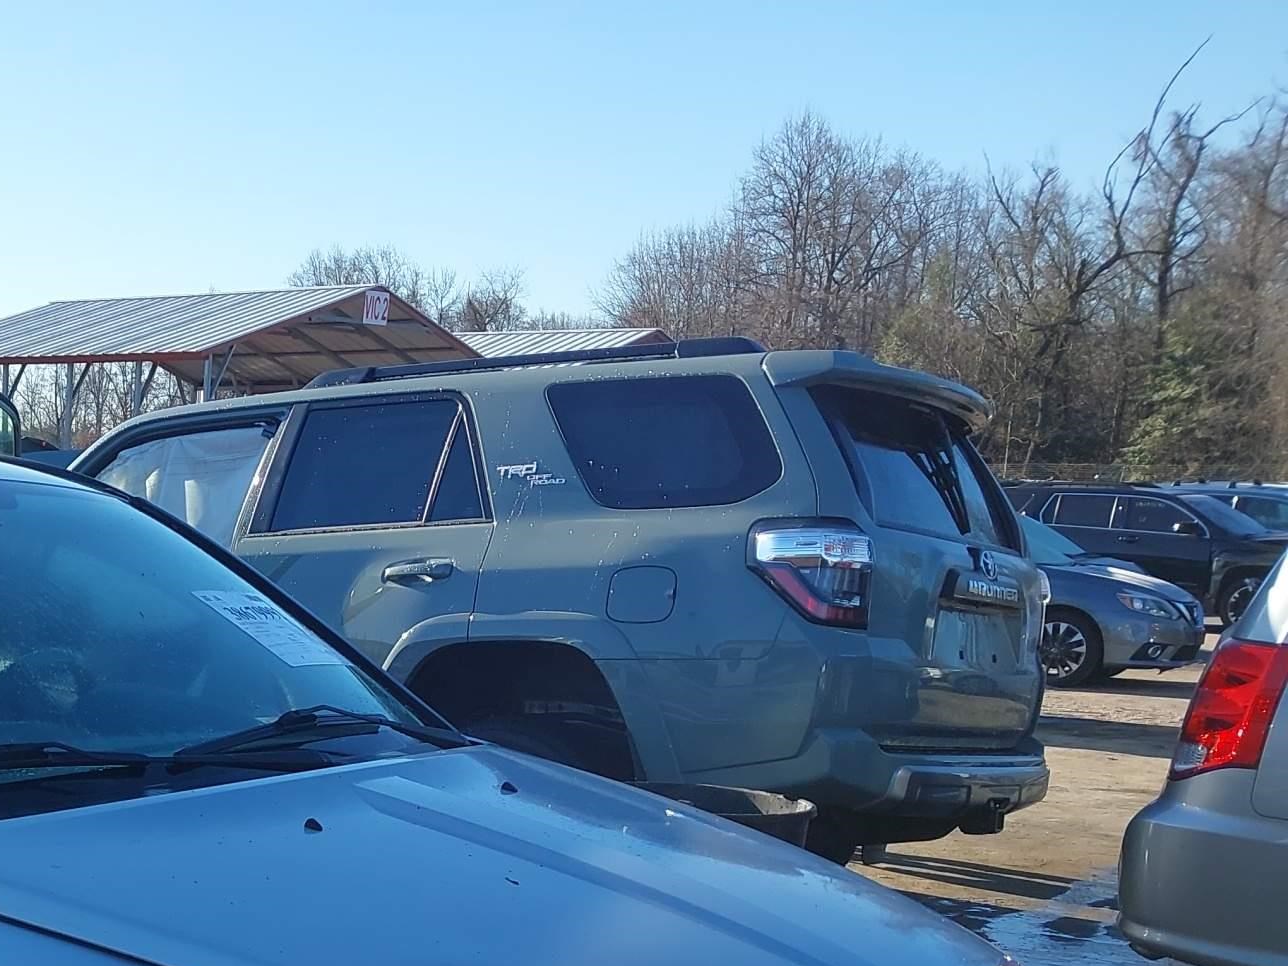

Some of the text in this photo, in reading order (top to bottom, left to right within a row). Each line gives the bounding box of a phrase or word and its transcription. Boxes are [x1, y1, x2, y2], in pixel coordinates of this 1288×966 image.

[365, 295, 389, 320] VIC 2
[496, 461, 537, 479] TRD
[530, 478, 566, 488] ROAD
